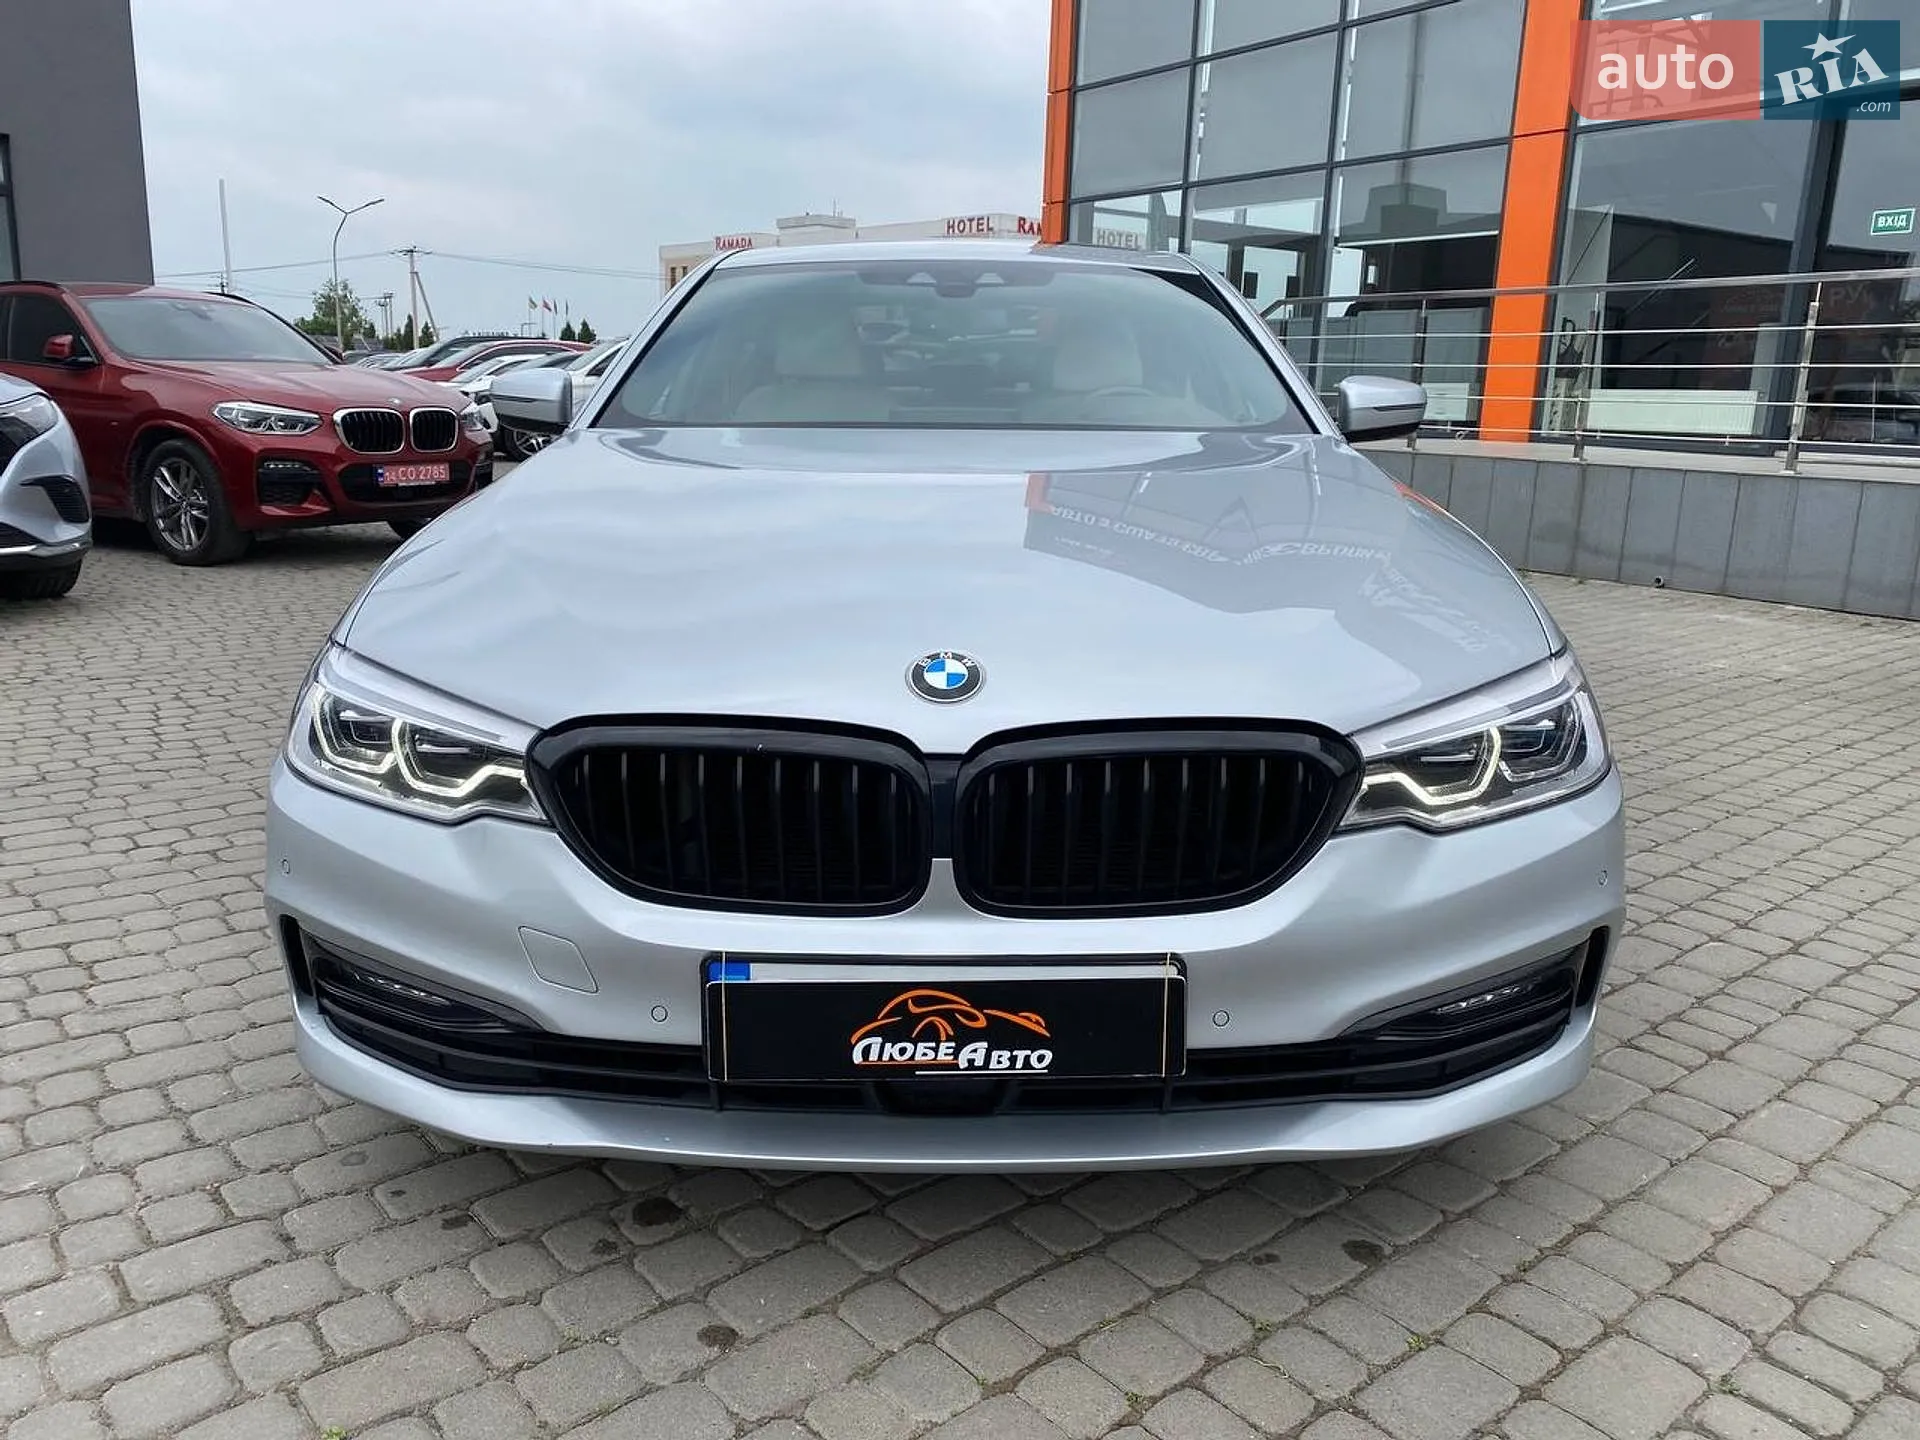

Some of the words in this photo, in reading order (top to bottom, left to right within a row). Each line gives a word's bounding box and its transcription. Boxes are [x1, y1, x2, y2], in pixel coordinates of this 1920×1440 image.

[946, 217, 994, 235] HOTEL
[1877, 214, 1907, 228] ВХІД
[714, 236, 753, 250] RAMADA
[1096, 228, 1141, 248] HOTEL
